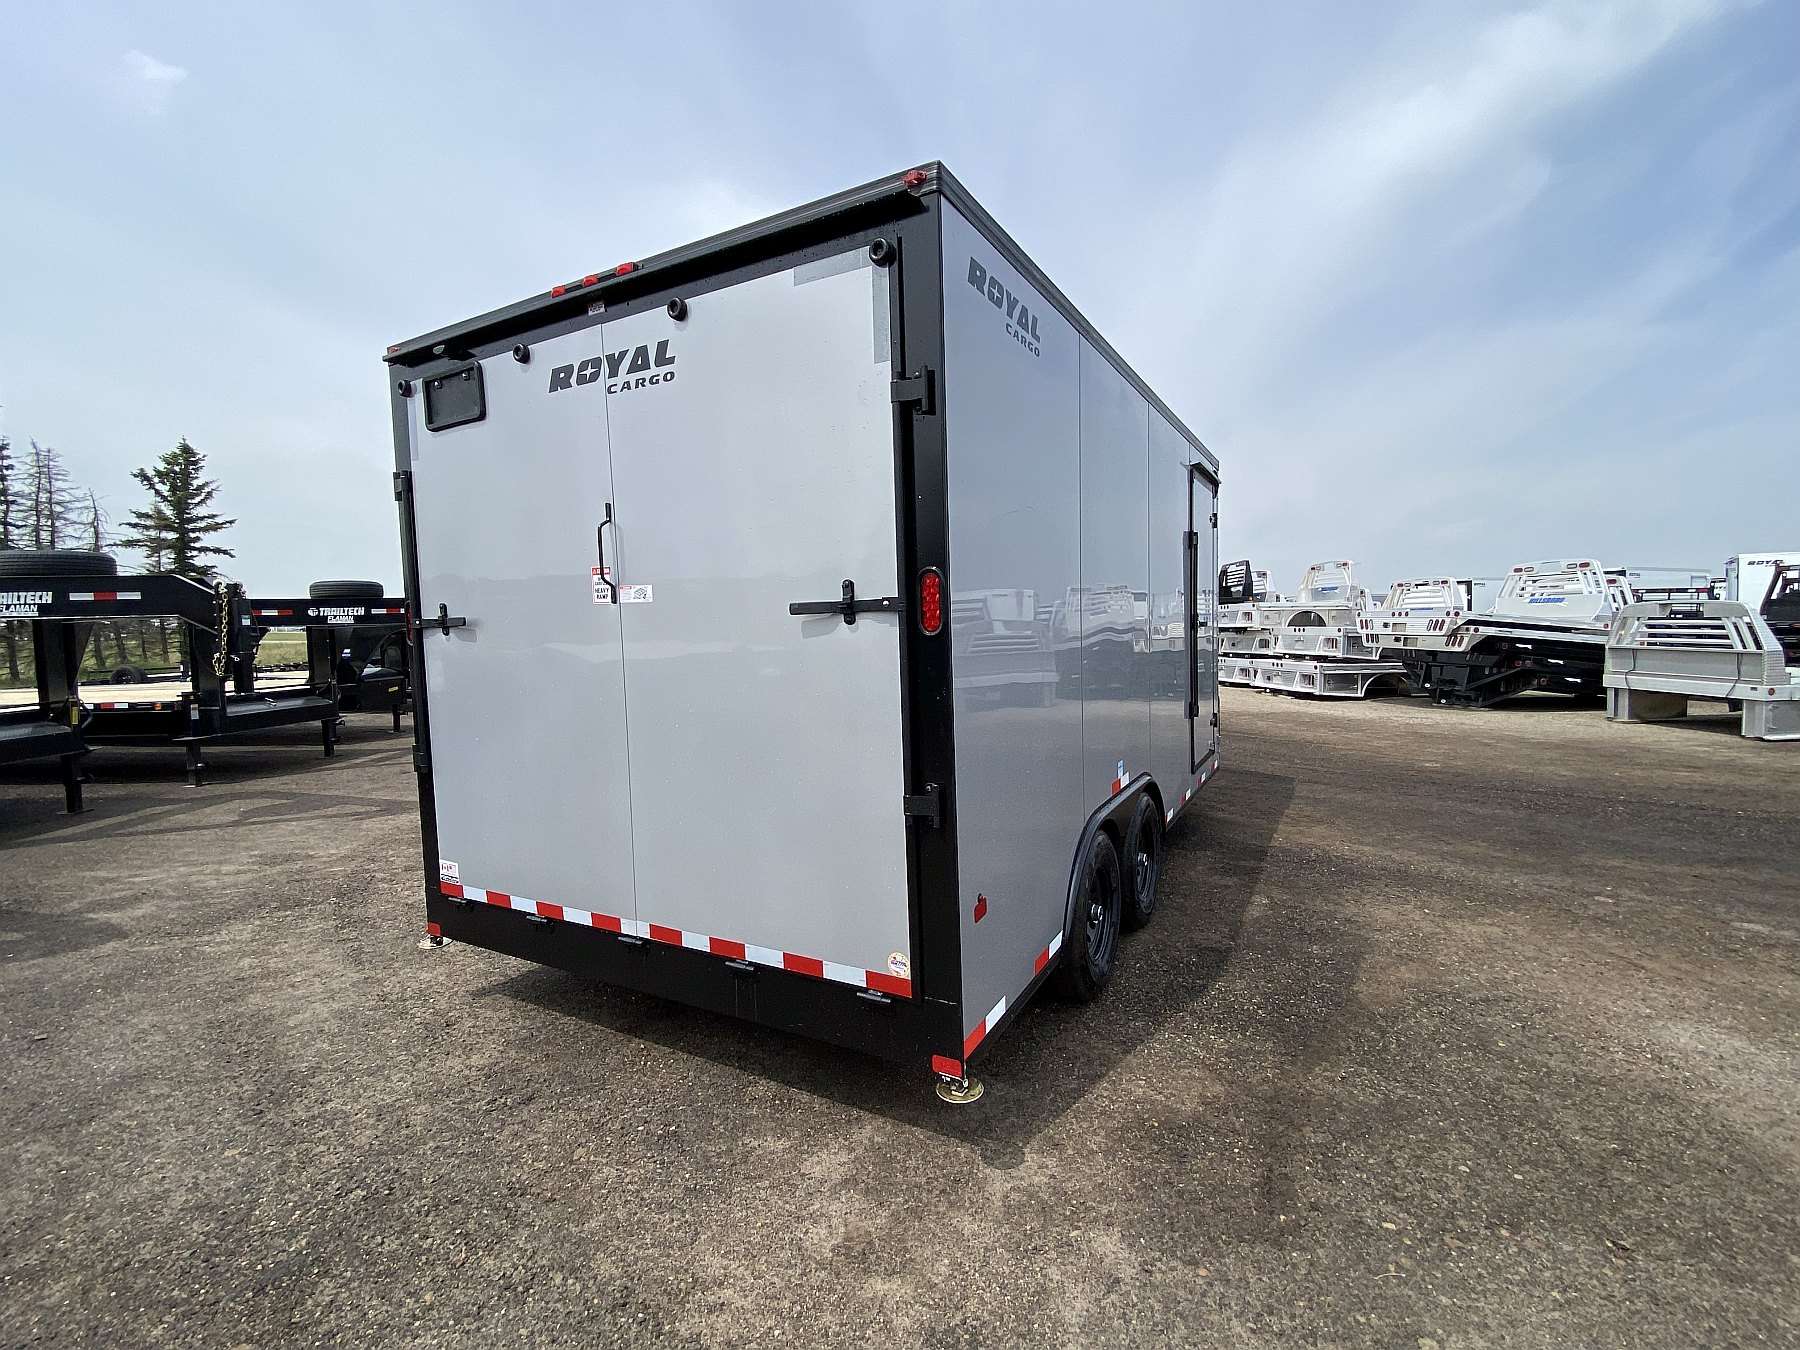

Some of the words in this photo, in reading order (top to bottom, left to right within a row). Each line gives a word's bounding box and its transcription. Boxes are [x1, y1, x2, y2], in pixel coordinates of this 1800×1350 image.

[968, 256, 1040, 344] ROYAL
[1006, 322, 1040, 358] CARGO
[548, 339, 676, 393] ROYAL
[607, 371, 675, 394] CARGO
[319, 607, 365, 616] TRAILTECH
